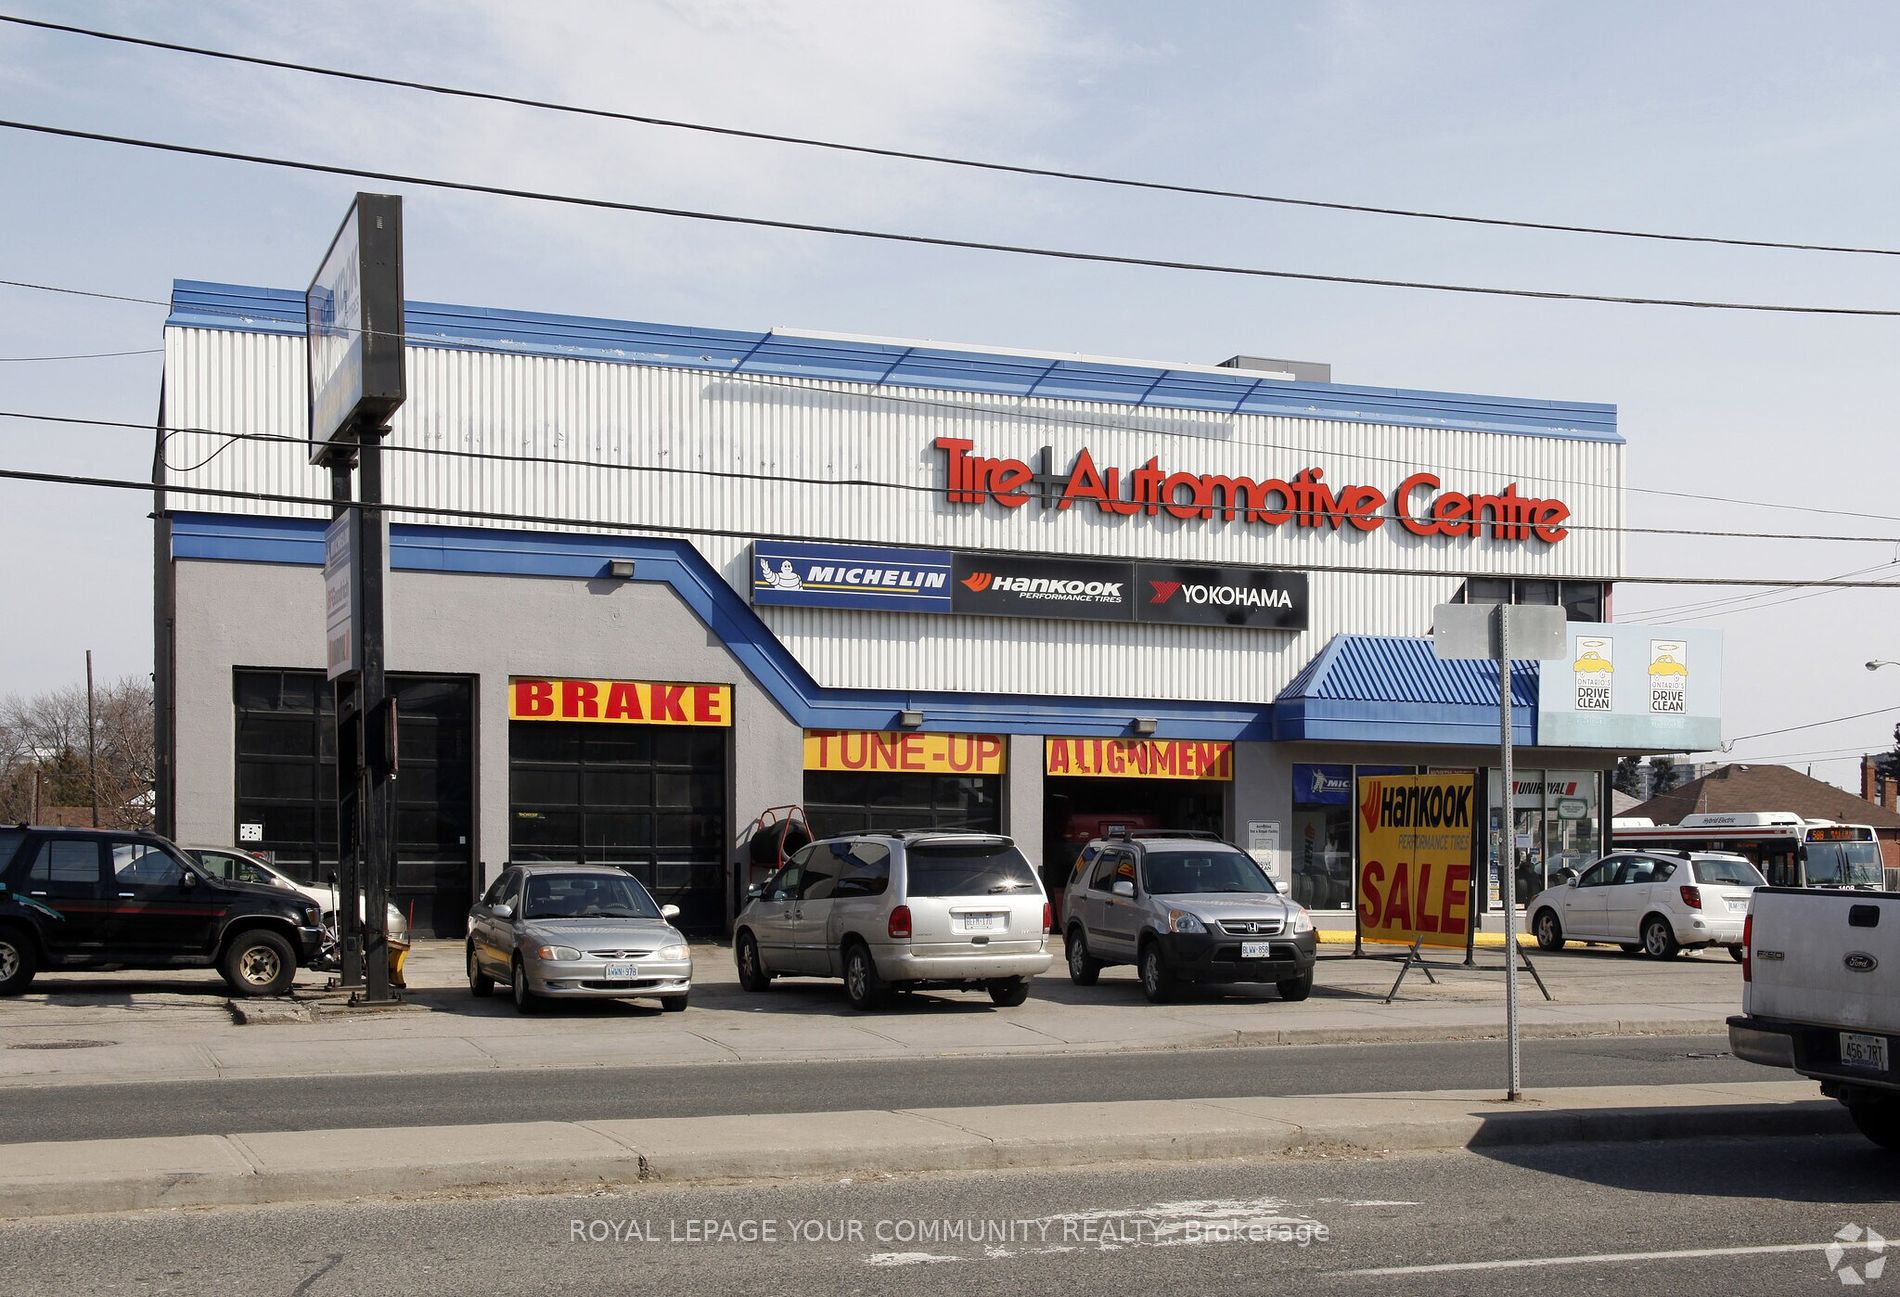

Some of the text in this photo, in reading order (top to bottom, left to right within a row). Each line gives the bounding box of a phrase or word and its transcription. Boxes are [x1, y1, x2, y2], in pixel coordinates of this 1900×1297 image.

[934, 437, 1033, 508] Tire
[1057, 447, 1387, 531] Automotive
[1395, 472, 1571, 543] Centre
[806, 566, 947, 588] MICHELIN
[1019, 592, 1122, 603] PERFORMANCE TIRES
[1181, 583, 1293, 609] YOKOHAMA
[515, 679, 722, 722] BRAKE
[1577, 687, 1610, 699] DRIVE
[1577, 698, 1609, 709] CLEAN
[1652, 690, 1684, 701] DRIVE
[1652, 701, 1683, 712] CLEAN
[810, 730, 1001, 770] TUNE-UP
[1048, 738, 1232, 777] ALIGNMENT
[1399, 834, 1470, 850] PERFORMANCE TIRES
[1359, 861, 1471, 935] SALE
